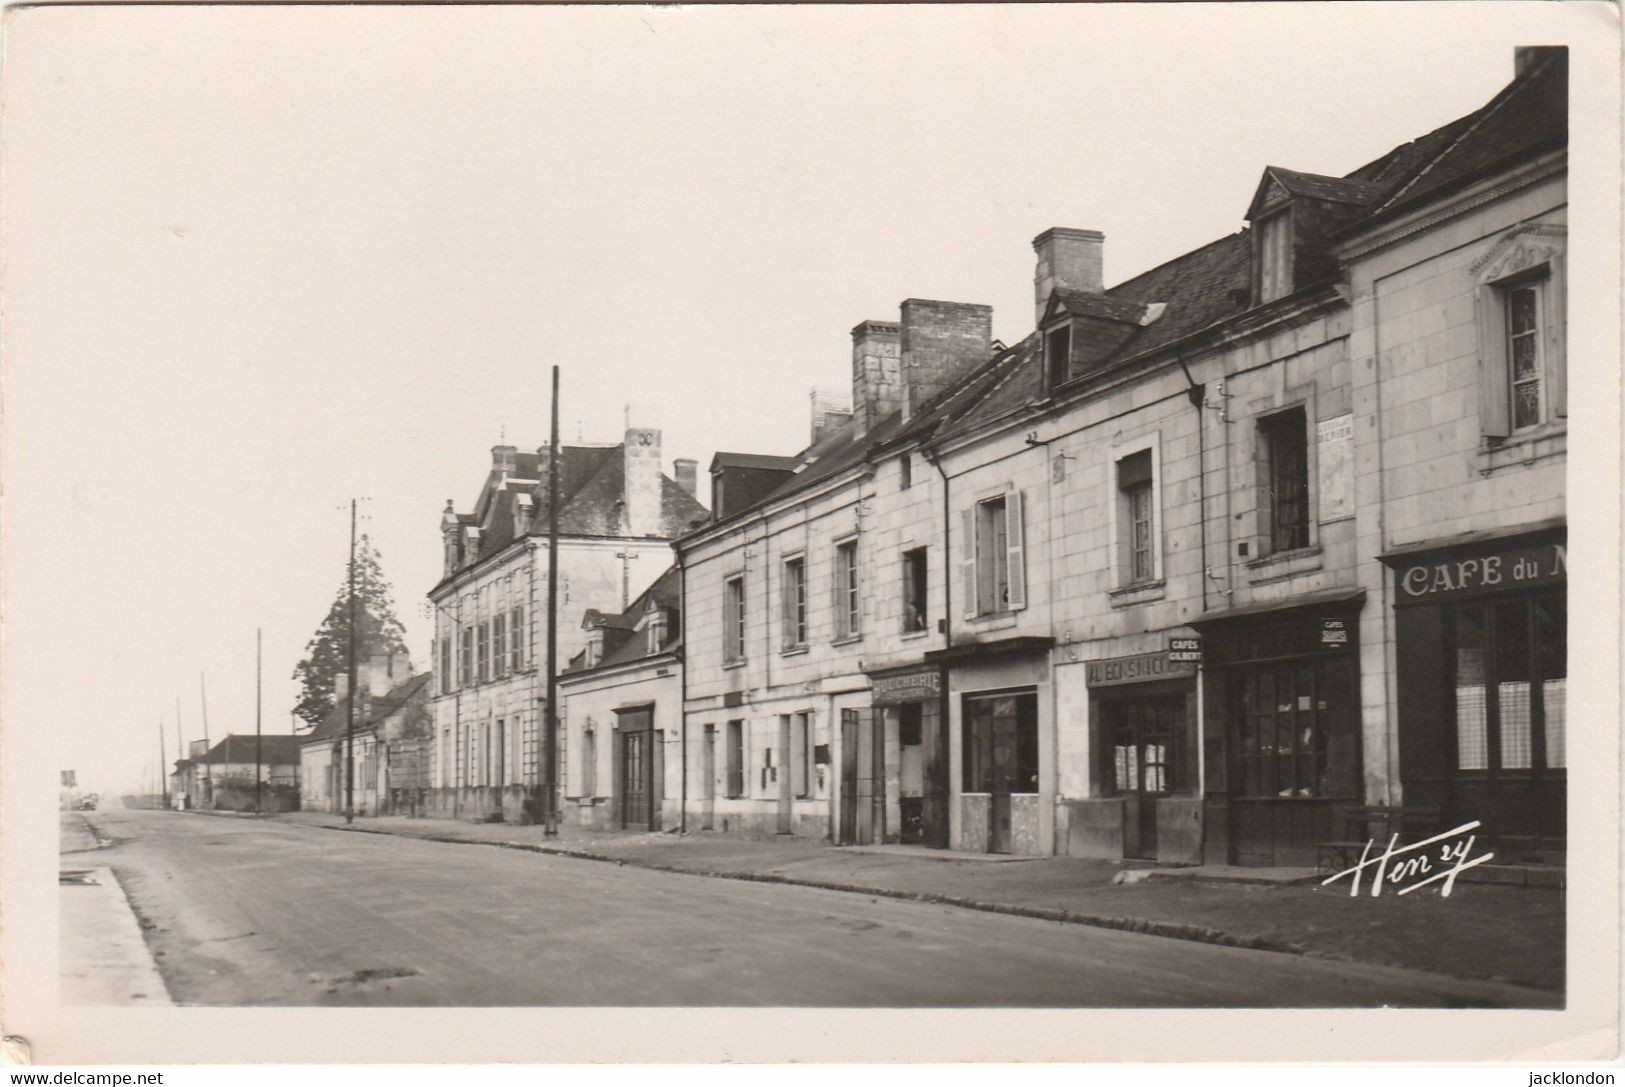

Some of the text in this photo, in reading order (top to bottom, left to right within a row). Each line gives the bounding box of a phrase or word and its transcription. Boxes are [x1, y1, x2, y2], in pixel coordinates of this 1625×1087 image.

[1401, 556, 1502, 597] CAFE
[1513, 557, 1538, 581] du
[1168, 651, 1203, 661] GILBERT
[873, 671, 941, 699] BOUCHERIE
